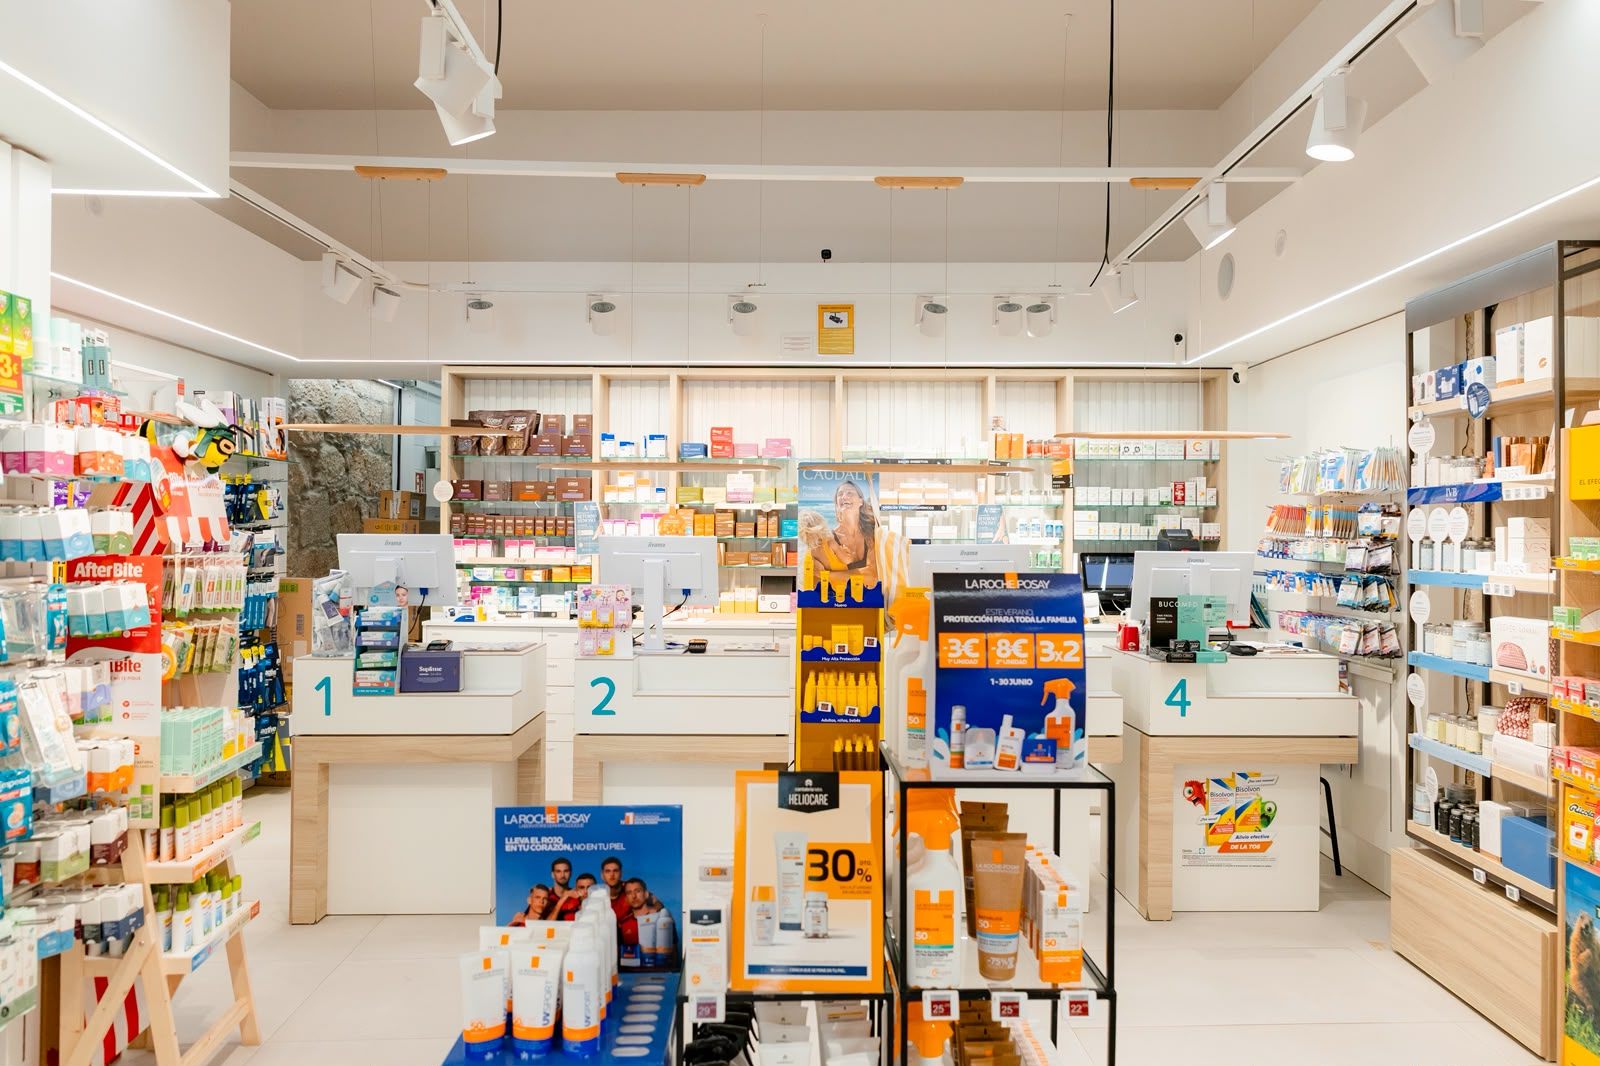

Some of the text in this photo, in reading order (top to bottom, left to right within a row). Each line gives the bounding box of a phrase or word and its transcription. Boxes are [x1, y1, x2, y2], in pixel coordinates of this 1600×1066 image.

[943, 614, 994, 623] PROTECCIÓN
[1039, 640, 1080, 662] 3x2
[1009, 678, 1033, 686] JUNIO
[314, 676, 331, 716] 1
[590, 677, 616, 716] 2
[1165, 678, 1191, 717] 4
[788, 793, 829, 805] HELIOCARE
[557, 813, 591, 824] POSAY
[542, 836, 563, 844] ROJO
